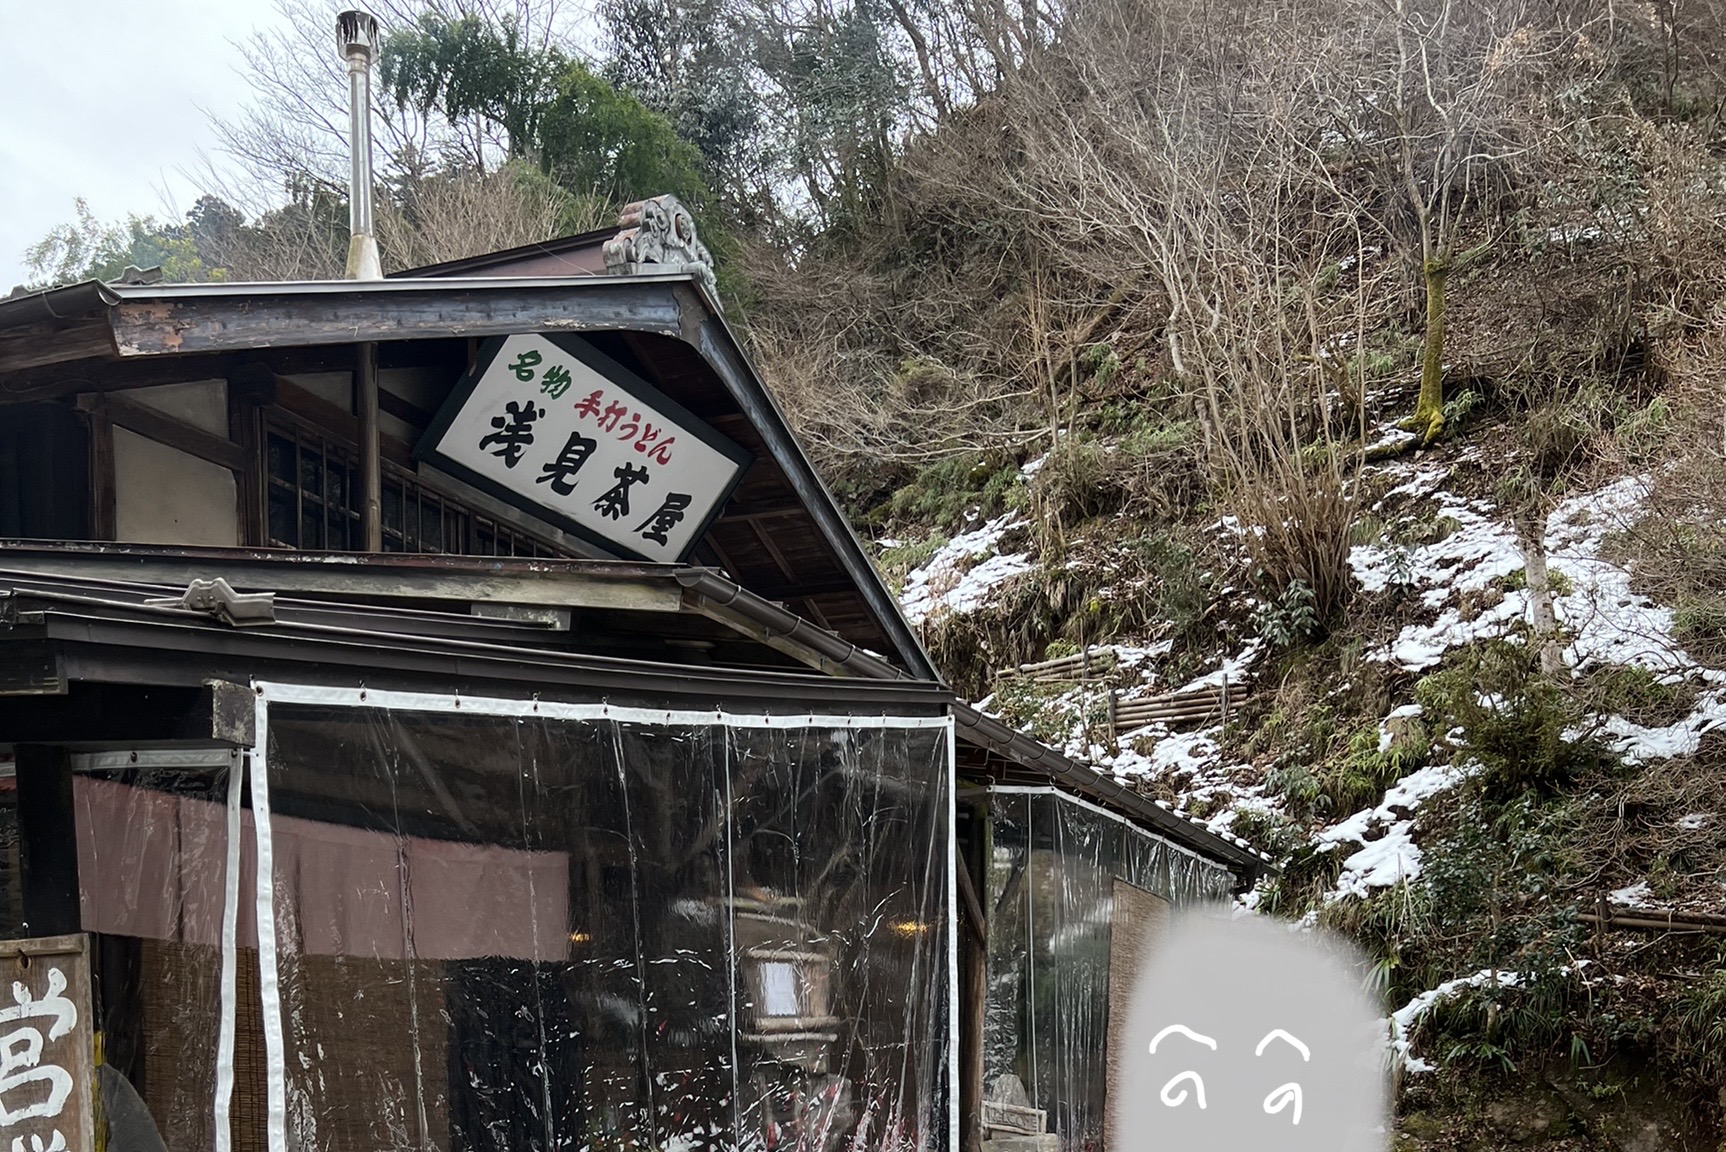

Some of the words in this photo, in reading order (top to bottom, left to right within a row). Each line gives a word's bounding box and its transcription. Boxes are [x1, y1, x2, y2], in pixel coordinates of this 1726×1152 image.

[478, 399, 693, 548] 浅見茶屋
[508, 350, 572, 400] 名物
[574, 390, 676, 466] 手打うどん
